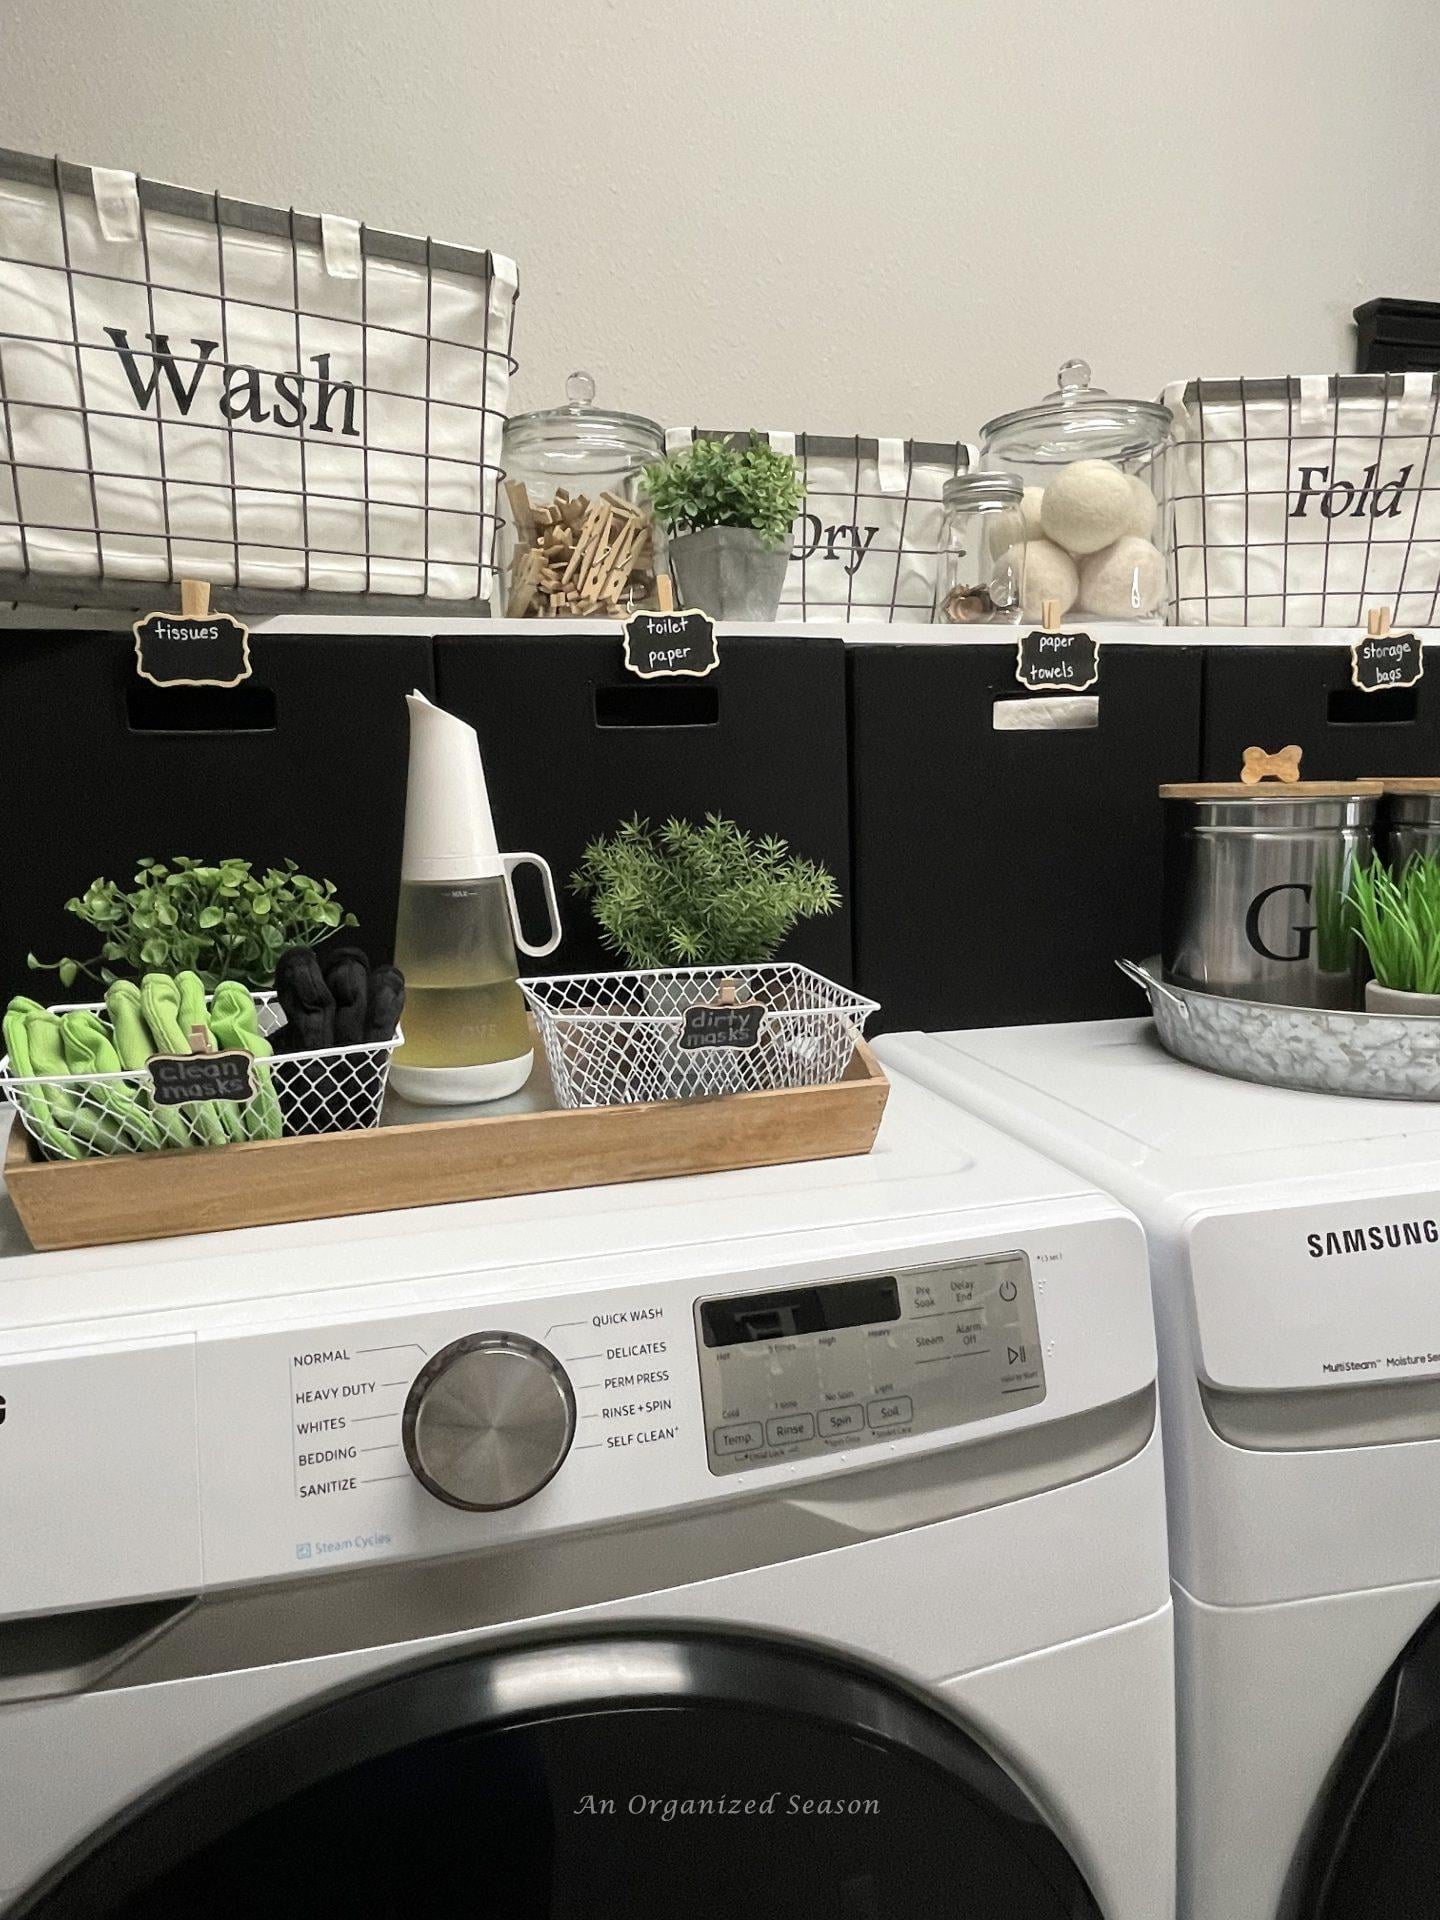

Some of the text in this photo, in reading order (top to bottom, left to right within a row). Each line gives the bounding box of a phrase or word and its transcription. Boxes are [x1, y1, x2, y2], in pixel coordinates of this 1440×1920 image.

[103, 326, 360, 437] Wash
[1290, 463, 1414, 518] Fold
[788, 513, 880, 576] Dry
[155, 620, 219, 640] tissues
[647, 617, 689, 634] toilet
[1040, 636, 1075, 652] paper
[1363, 642, 1412, 661] storage
[648, 647, 692, 668] paper
[1030, 661, 1074, 680] towels
[1376, 667, 1402, 685] bags
[1245, 884, 1318, 962] G
[691, 1010, 751, 1031] dirty
[687, 1027, 749, 1046] masks
[159, 1062, 239, 1080] clean
[162, 1079, 244, 1098] masks
[1307, 1220, 1439, 1258] SAMSUNG
[951, 1280, 974, 1291] Delay
[914, 1298, 935, 1309] Soak
[956, 1292, 972, 1302] End
[592, 1308, 663, 1327] QUICK WASH
[956, 1322, 982, 1334] Alarm
[915, 1335, 944, 1347] Steam
[962, 1334, 977, 1345] Off
[294, 1349, 350, 1367] NORMAL
[607, 1341, 667, 1360] DELICATES
[1387, 1353, 1426, 1367] Moisture
[1427, 1352, 1440, 1363] Se
[604, 1370, 670, 1389] PERM PRESS
[296, 1381, 376, 1404] HEAVY DUTY
[602, 1404, 635, 1418] RINSE
[645, 1400, 672, 1413] SPIN
[881, 1406, 900, 1419] Soil
[297, 1417, 346, 1434] WHITES
[775, 1424, 804, 1437] Rinse
[829, 1415, 853, 1428] Spin
[606, 1434, 633, 1448] SELF
[298, 1446, 357, 1466] BEDDING
[299, 1478, 357, 1498] SANITIZE
[316, 1533, 391, 1554] Steam Cycles
